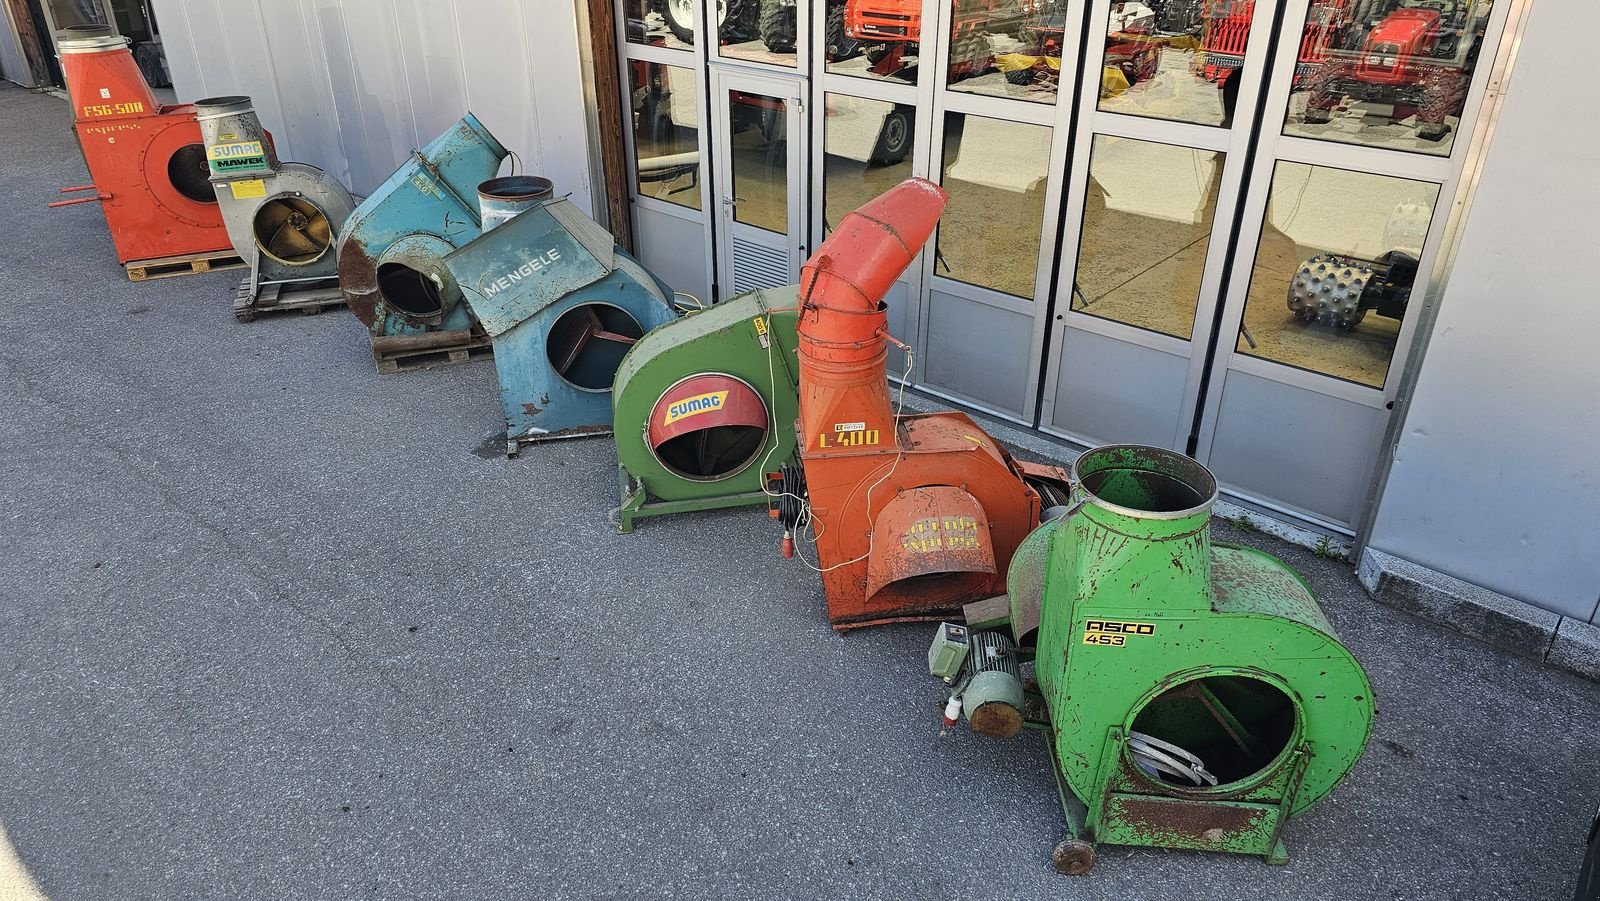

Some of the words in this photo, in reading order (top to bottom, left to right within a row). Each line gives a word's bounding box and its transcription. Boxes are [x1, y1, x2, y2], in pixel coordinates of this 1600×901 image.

[83, 102, 144, 117] FSG-500
[214, 143, 260, 157] SUMAG
[216, 157, 264, 168] MAWEK
[484, 248, 561, 297] MENGELE
[670, 396, 721, 418] SUMAG
[820, 430, 879, 448] L-400
[1086, 621, 1155, 635] ASCO
[1085, 634, 1125, 646] 453
